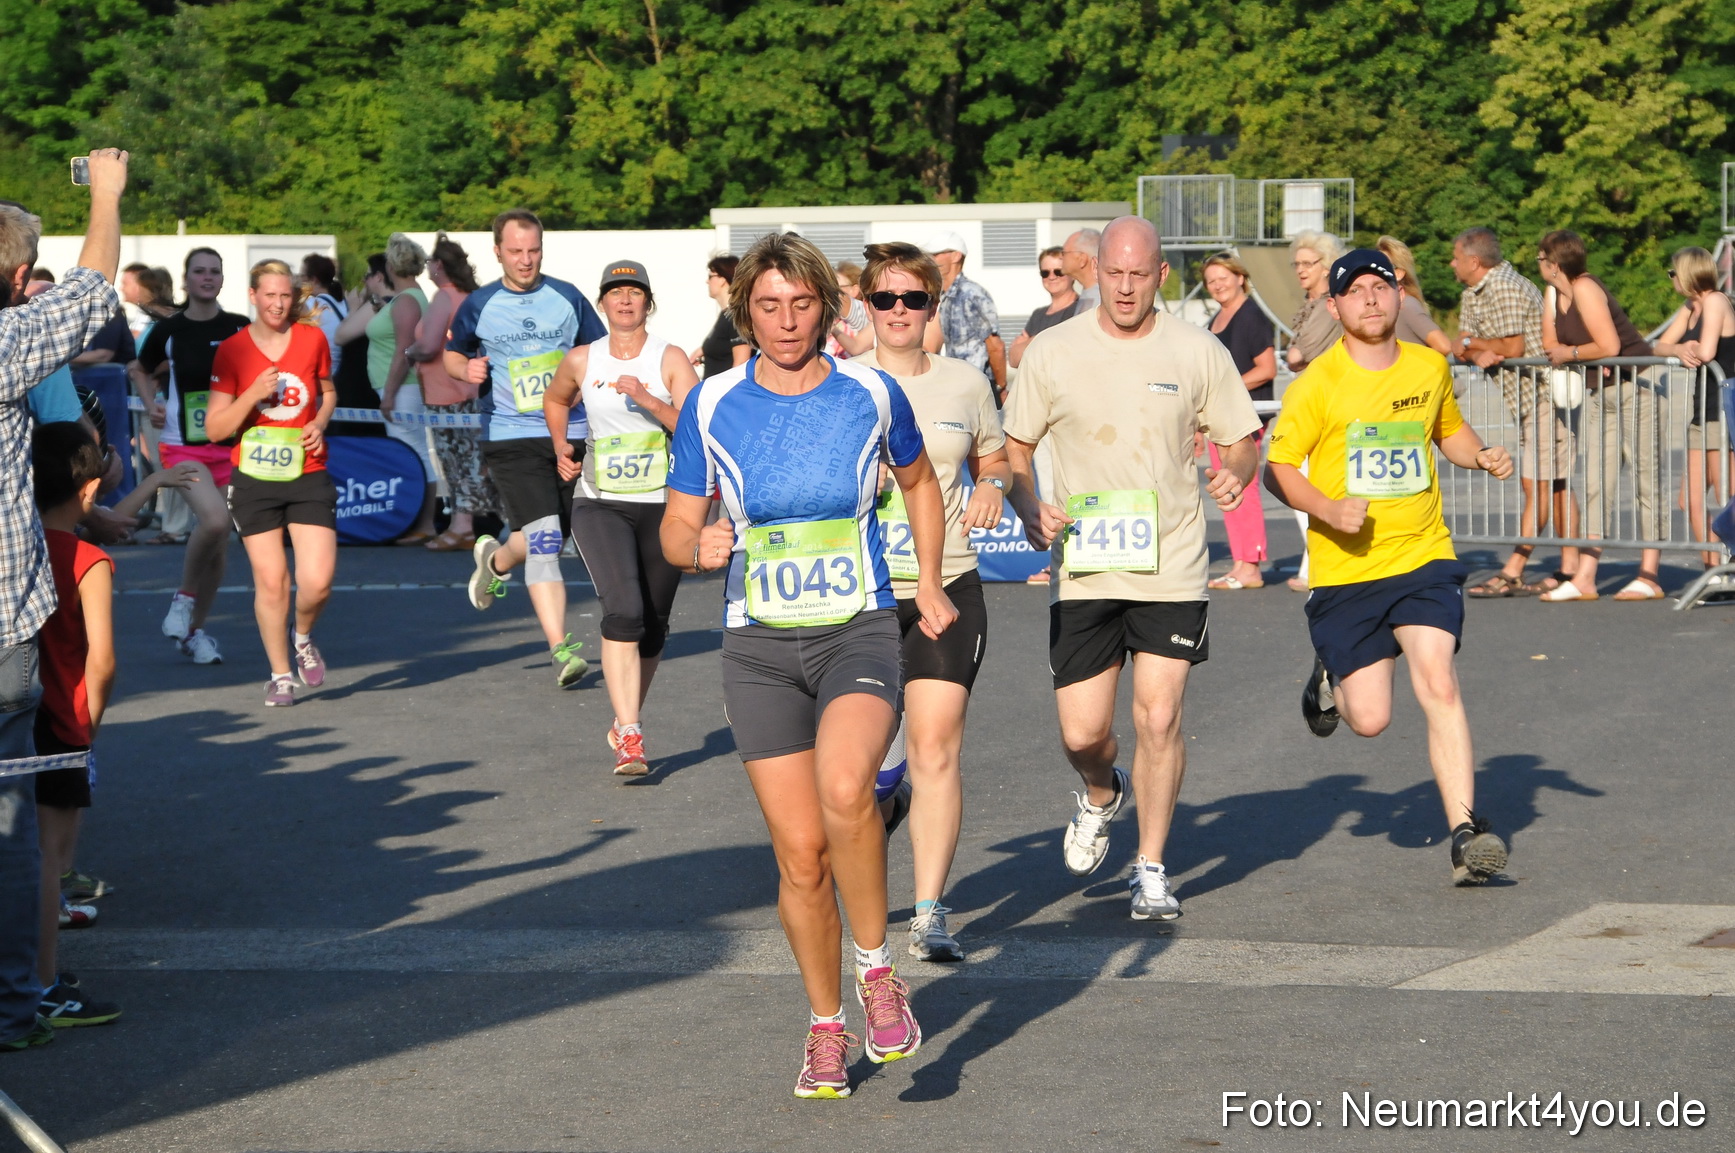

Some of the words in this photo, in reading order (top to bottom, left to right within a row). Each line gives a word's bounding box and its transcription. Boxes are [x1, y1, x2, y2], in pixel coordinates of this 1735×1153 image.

[249, 445, 292, 467] 449
[606, 453, 654, 479] 557
[1349, 448, 1421, 479] 1351
[333, 500, 394, 518] MOBILE
[1069, 518, 1152, 550] 1419
[750, 556, 858, 602] 1043
[804, 601, 831, 609] Zaschka
[1179, 637, 1194, 647] JAKO
